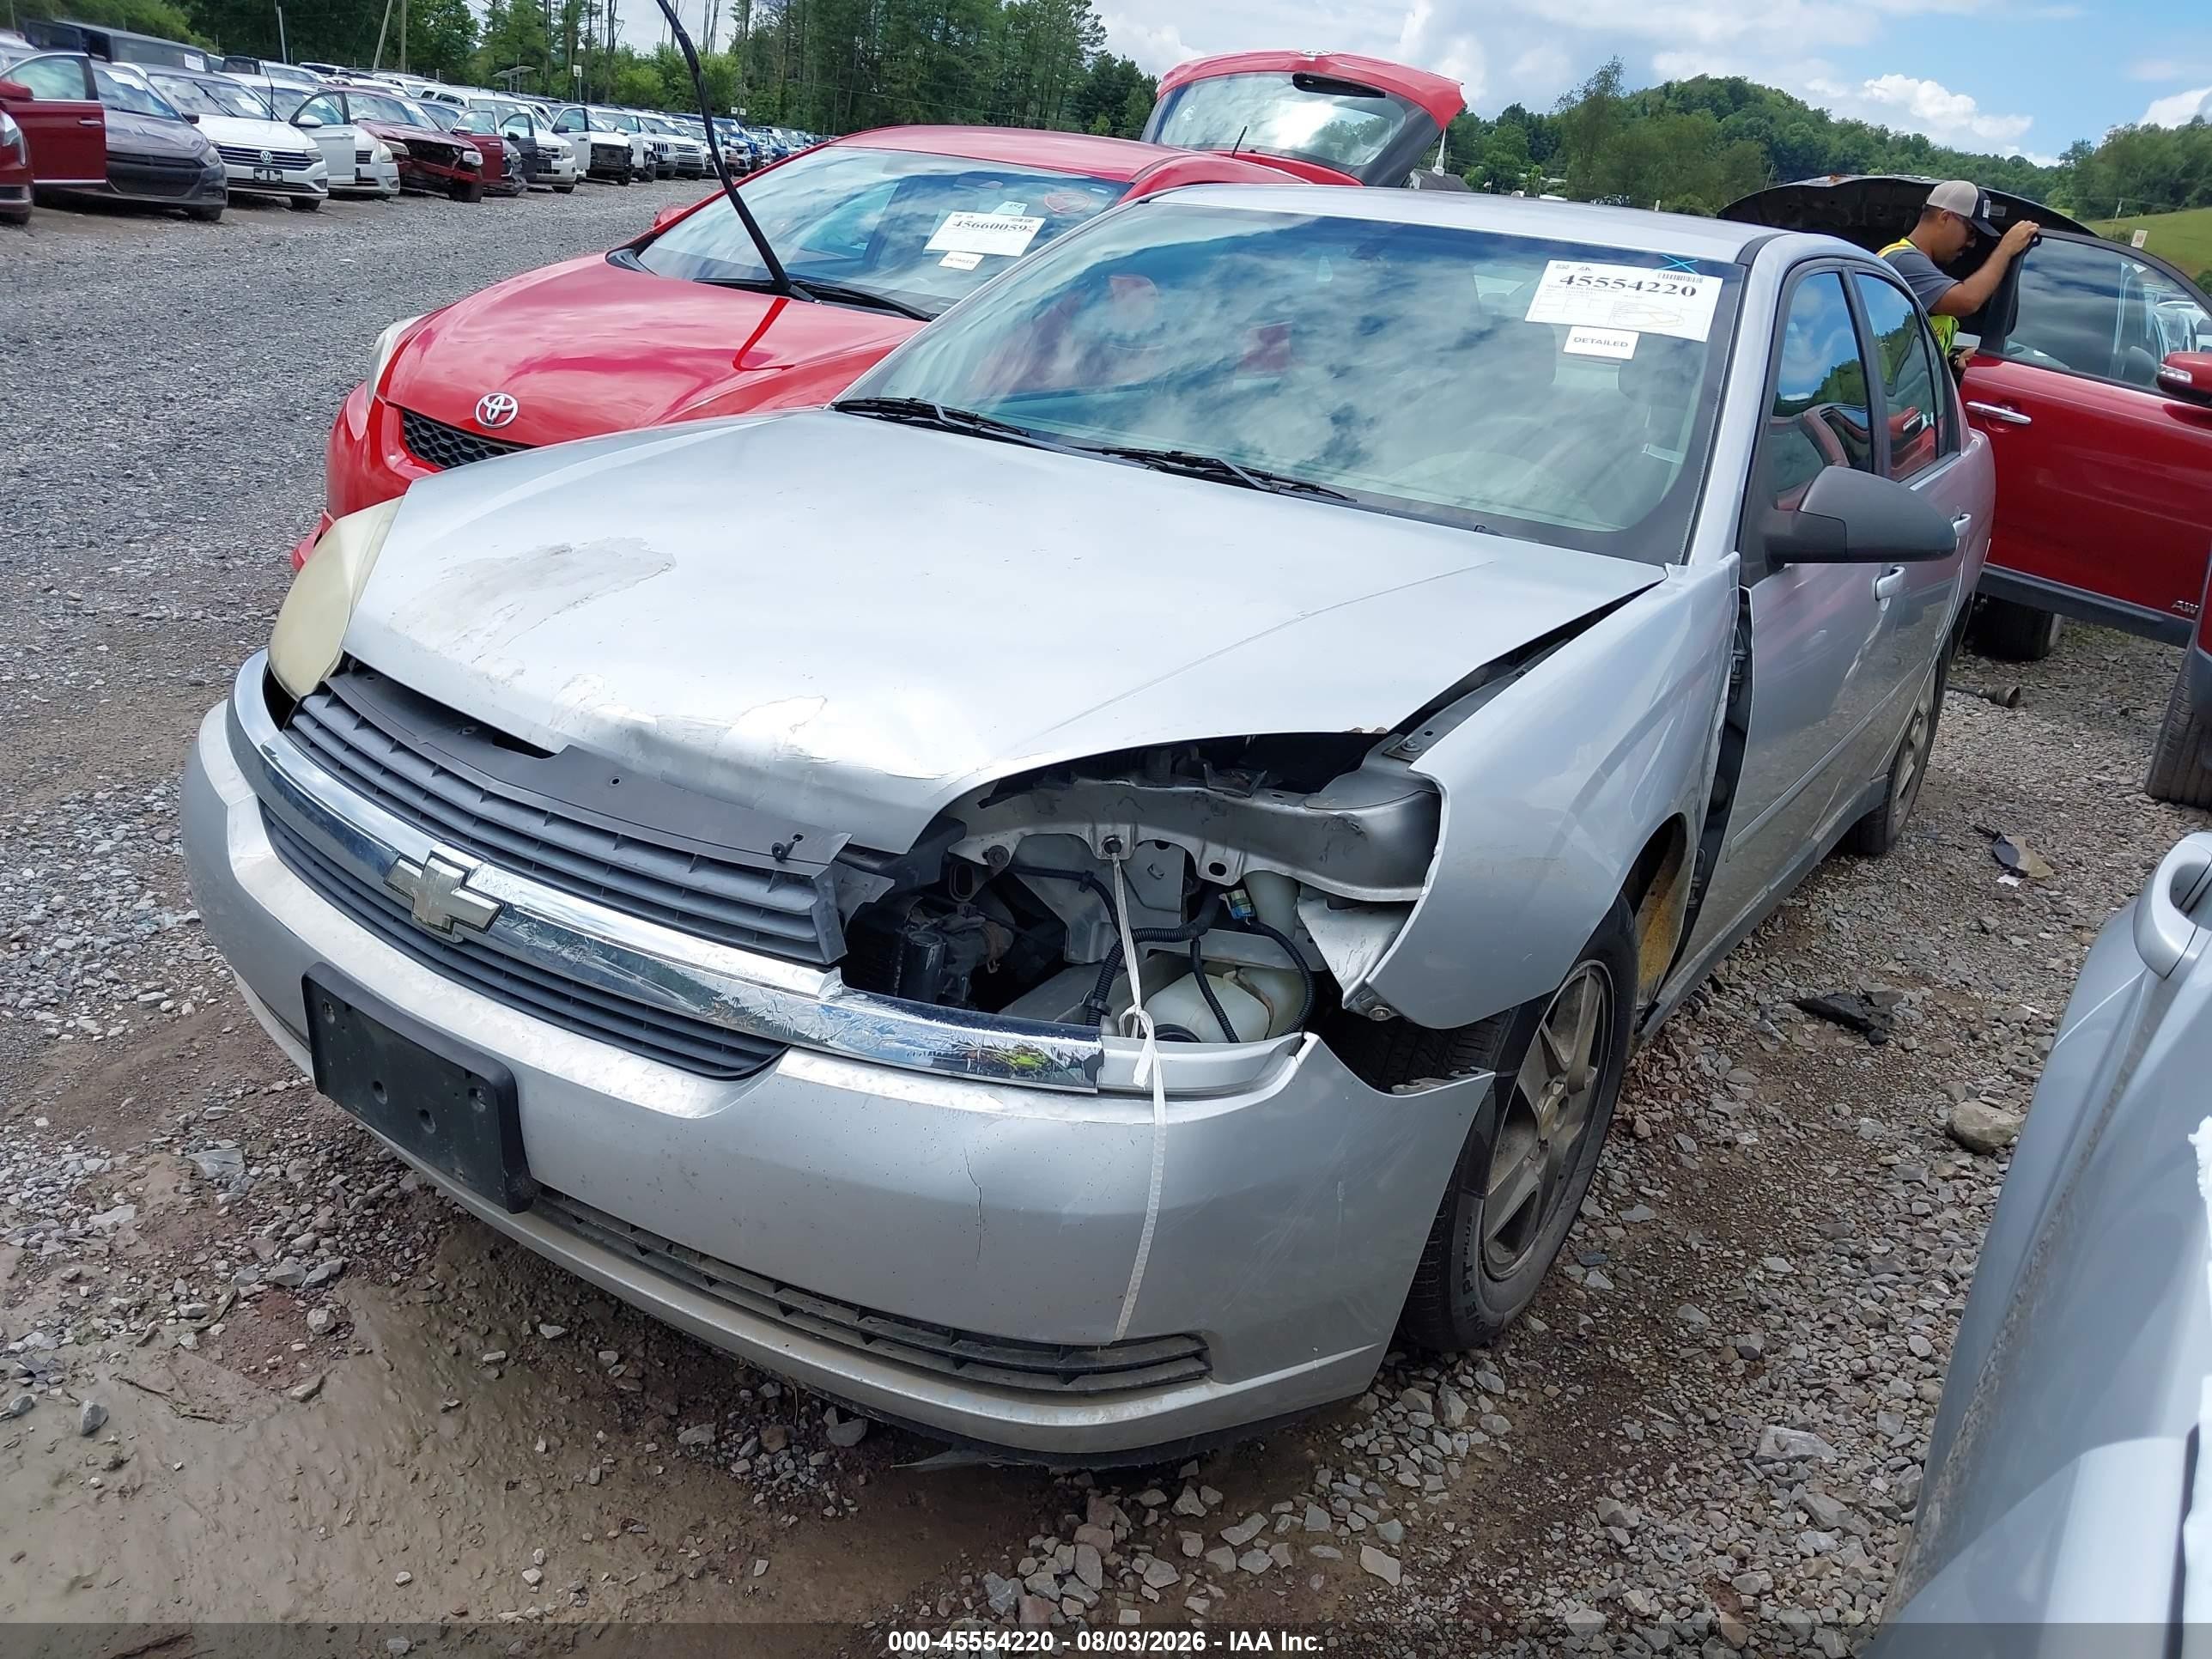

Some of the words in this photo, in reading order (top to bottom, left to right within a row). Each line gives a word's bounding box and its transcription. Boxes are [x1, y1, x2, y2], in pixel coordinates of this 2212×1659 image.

[952, 220, 1028, 233] 45660059
[1559, 274, 1697, 297] 45554220
[1573, 336, 1629, 349] DETAILED
[2171, 600, 2200, 614] AW
[1462, 1215, 1473, 1256] PLUS
[1462, 1261, 1473, 1295] PT
